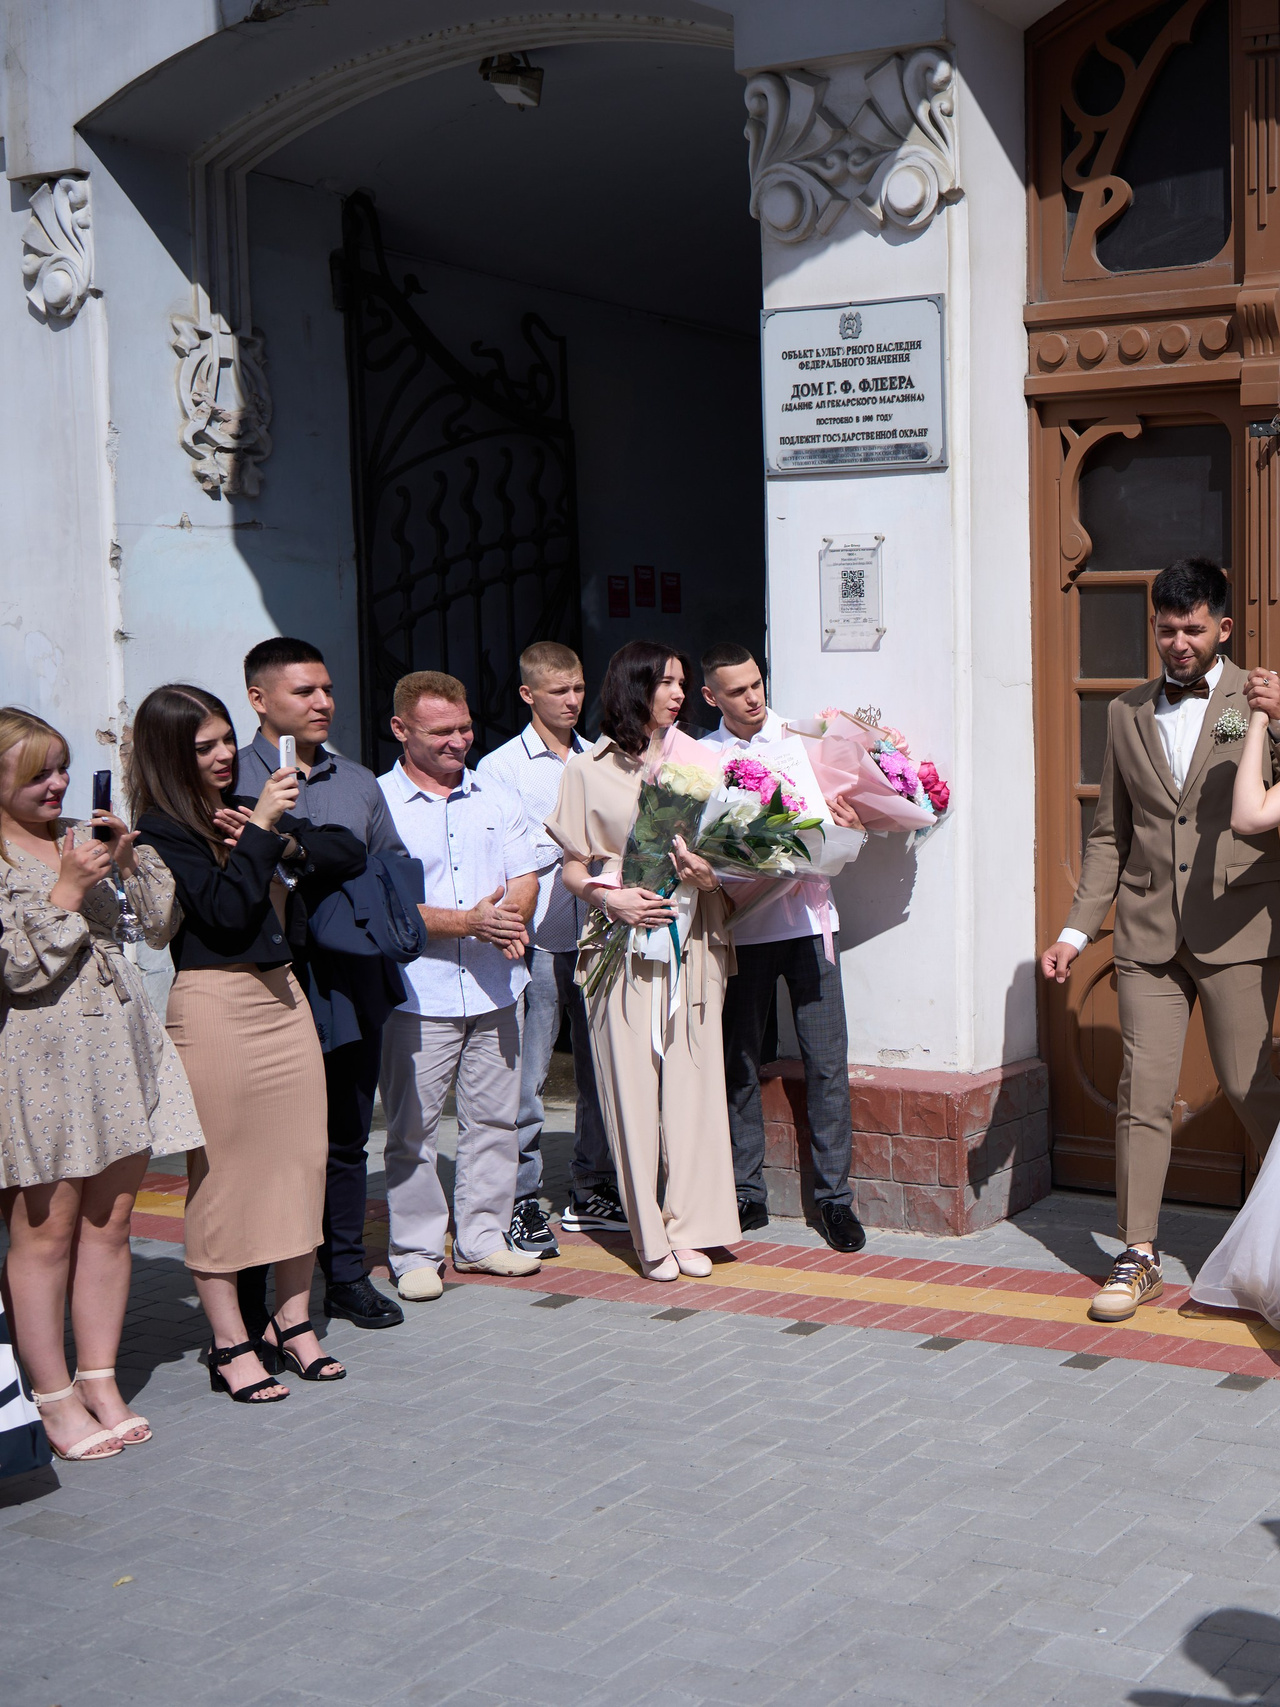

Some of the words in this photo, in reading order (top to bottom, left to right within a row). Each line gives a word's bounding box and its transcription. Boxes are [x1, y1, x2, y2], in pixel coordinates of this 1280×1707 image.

[876, 340, 922, 352] НАСЛЕДИЯ
[798, 357, 864, 371] ФЕДЕРАЛЬНОГО
[866, 353, 910, 365] ЗНАЧЕНИЯ
[791, 382, 824, 400] ДОМ
[827, 381, 837, 395] Г.
[840, 380, 856, 394] Ф.
[859, 376, 915, 392] ФЛЕЕРА
[879, 394, 924, 404] МАГАЗИНА)
[816, 416, 853, 425] ПОСТРОЕНО
[876, 414, 893, 422] ГОДУ
[780, 435, 821, 446] ПОДЛЕЖИТ
